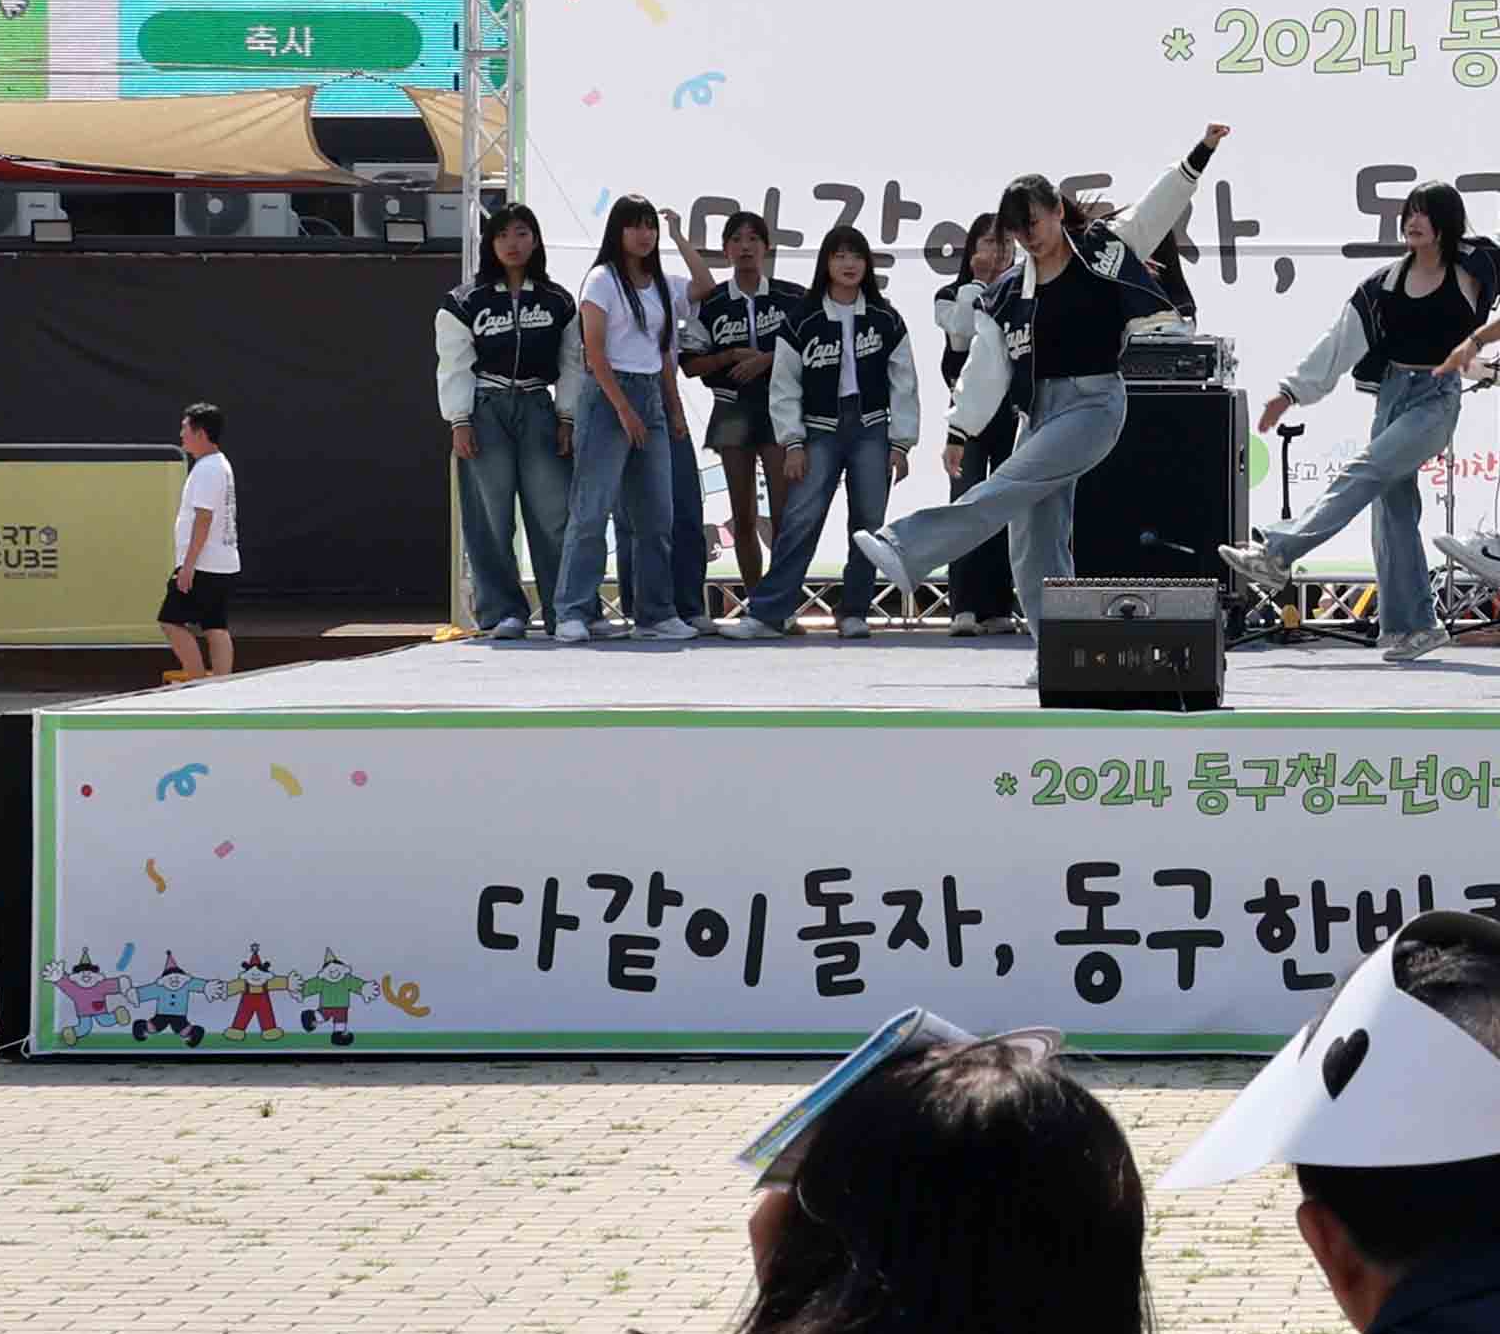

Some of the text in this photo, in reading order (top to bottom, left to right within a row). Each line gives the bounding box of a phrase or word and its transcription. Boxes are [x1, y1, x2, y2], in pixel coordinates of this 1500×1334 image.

[244, 25, 315, 59] 축사
[1215, 7, 1417, 77] 2024
[1030, 758, 1172, 806] 2024
[477, 870, 767, 994] 다같이
[797, 867, 1014, 998] 돌자,
[1055, 862, 1225, 1005] 동구
